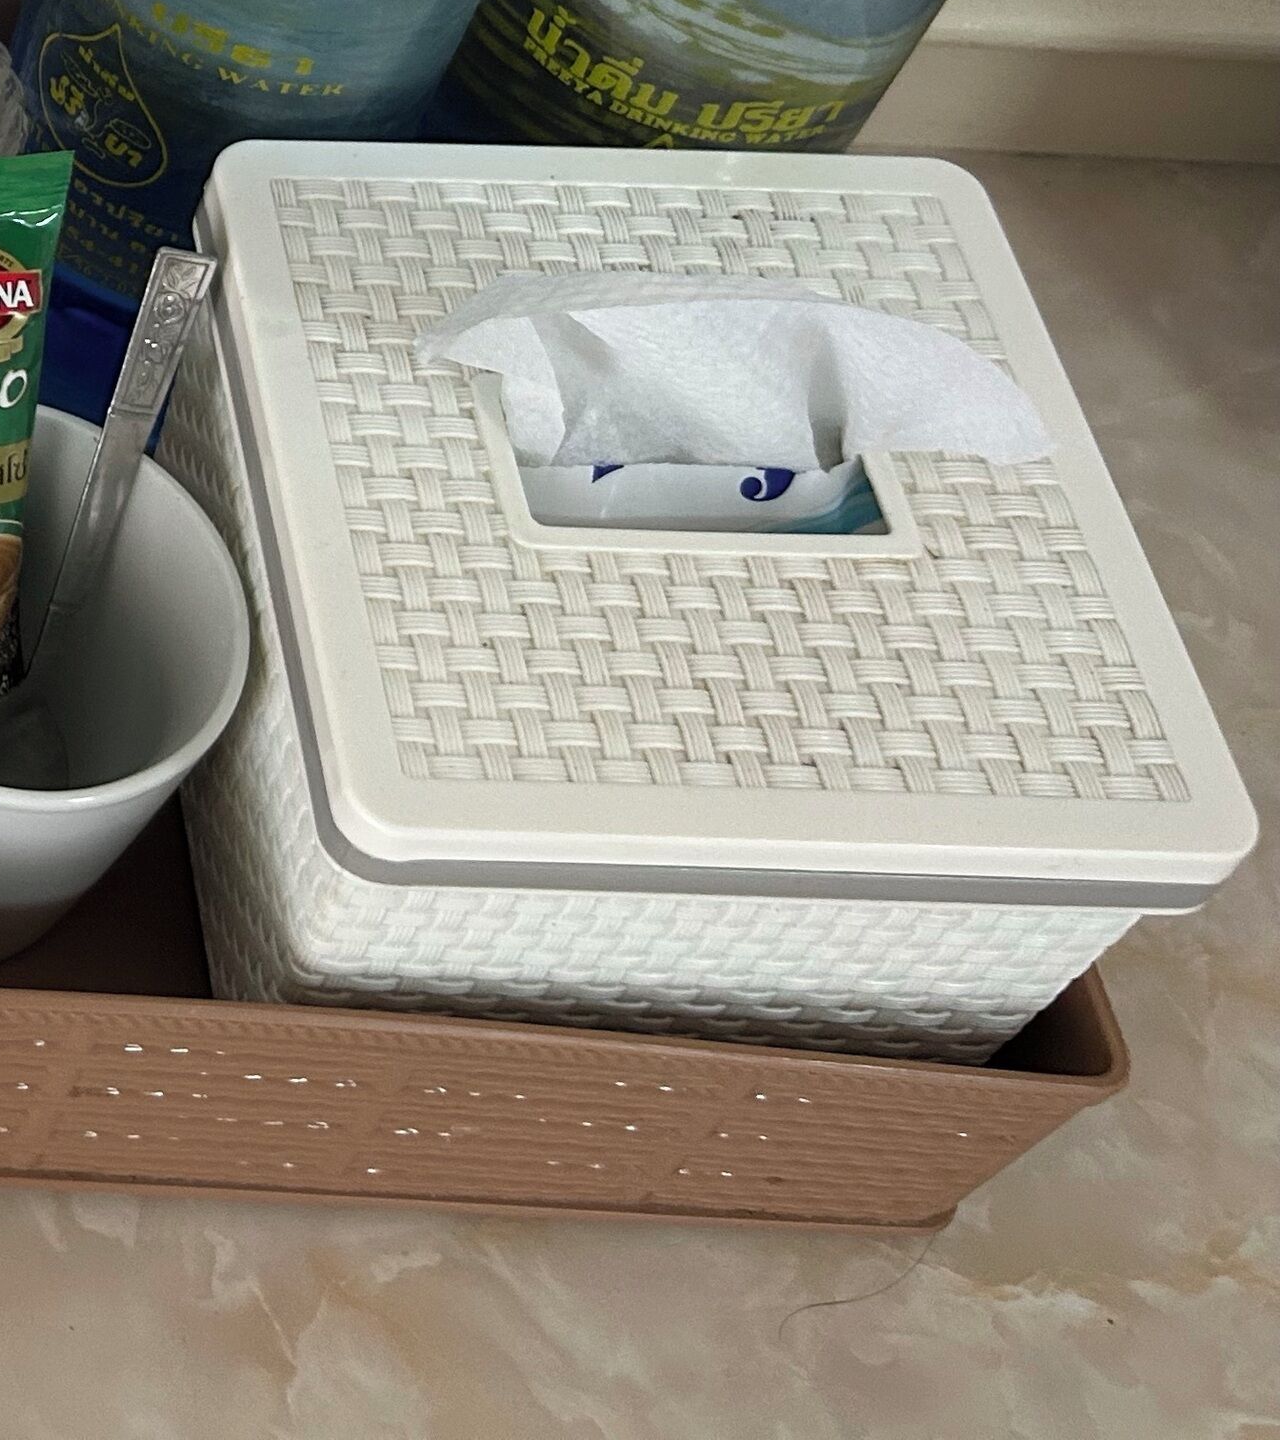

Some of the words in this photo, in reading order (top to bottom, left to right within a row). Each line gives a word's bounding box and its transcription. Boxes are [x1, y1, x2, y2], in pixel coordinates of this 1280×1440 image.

[217, 65, 346, 98] WATER
[526, 4, 680, 117] น้ำดื่ม
[696, 99, 846, 135] ปรียา
[609, 100, 738, 144] DRINKING
[744, 124, 827, 146] WATER
